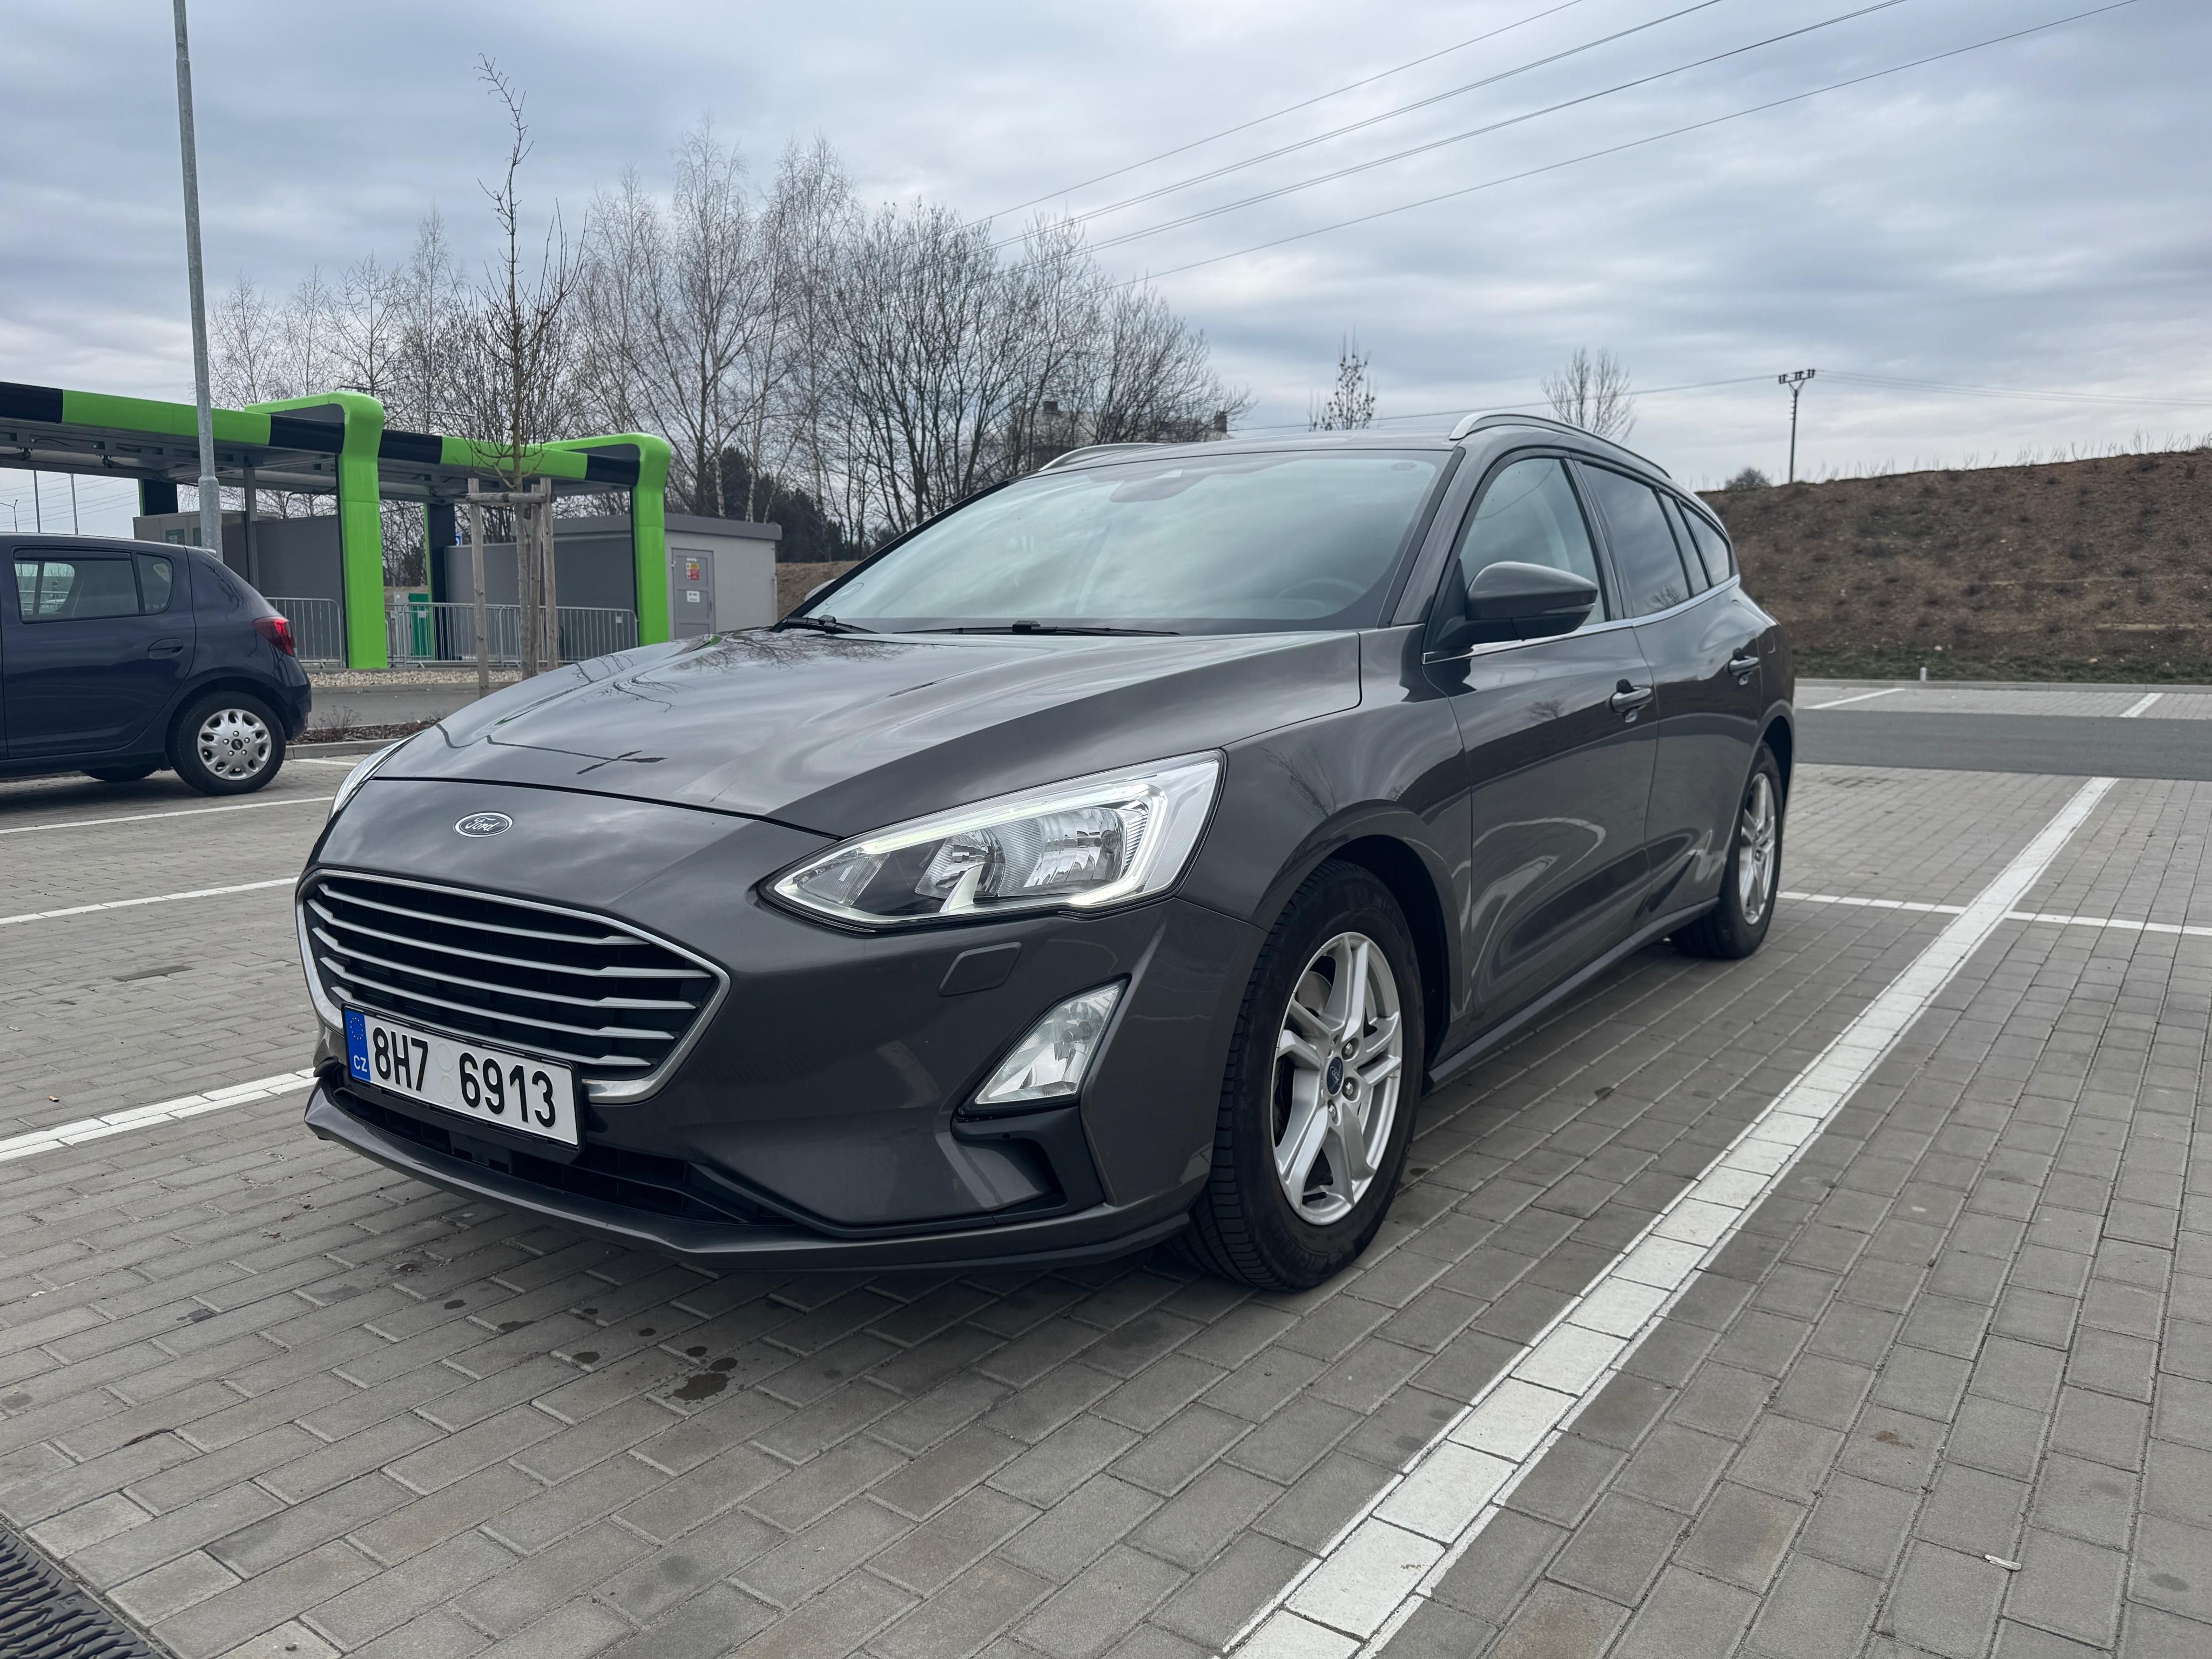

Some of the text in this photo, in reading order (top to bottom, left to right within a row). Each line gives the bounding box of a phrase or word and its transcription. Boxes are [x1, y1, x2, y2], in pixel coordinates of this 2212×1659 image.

[464, 817, 500, 832] Ford
[353, 1054, 368, 1073] CZ
[373, 1027, 556, 1128] 8H7 6913
